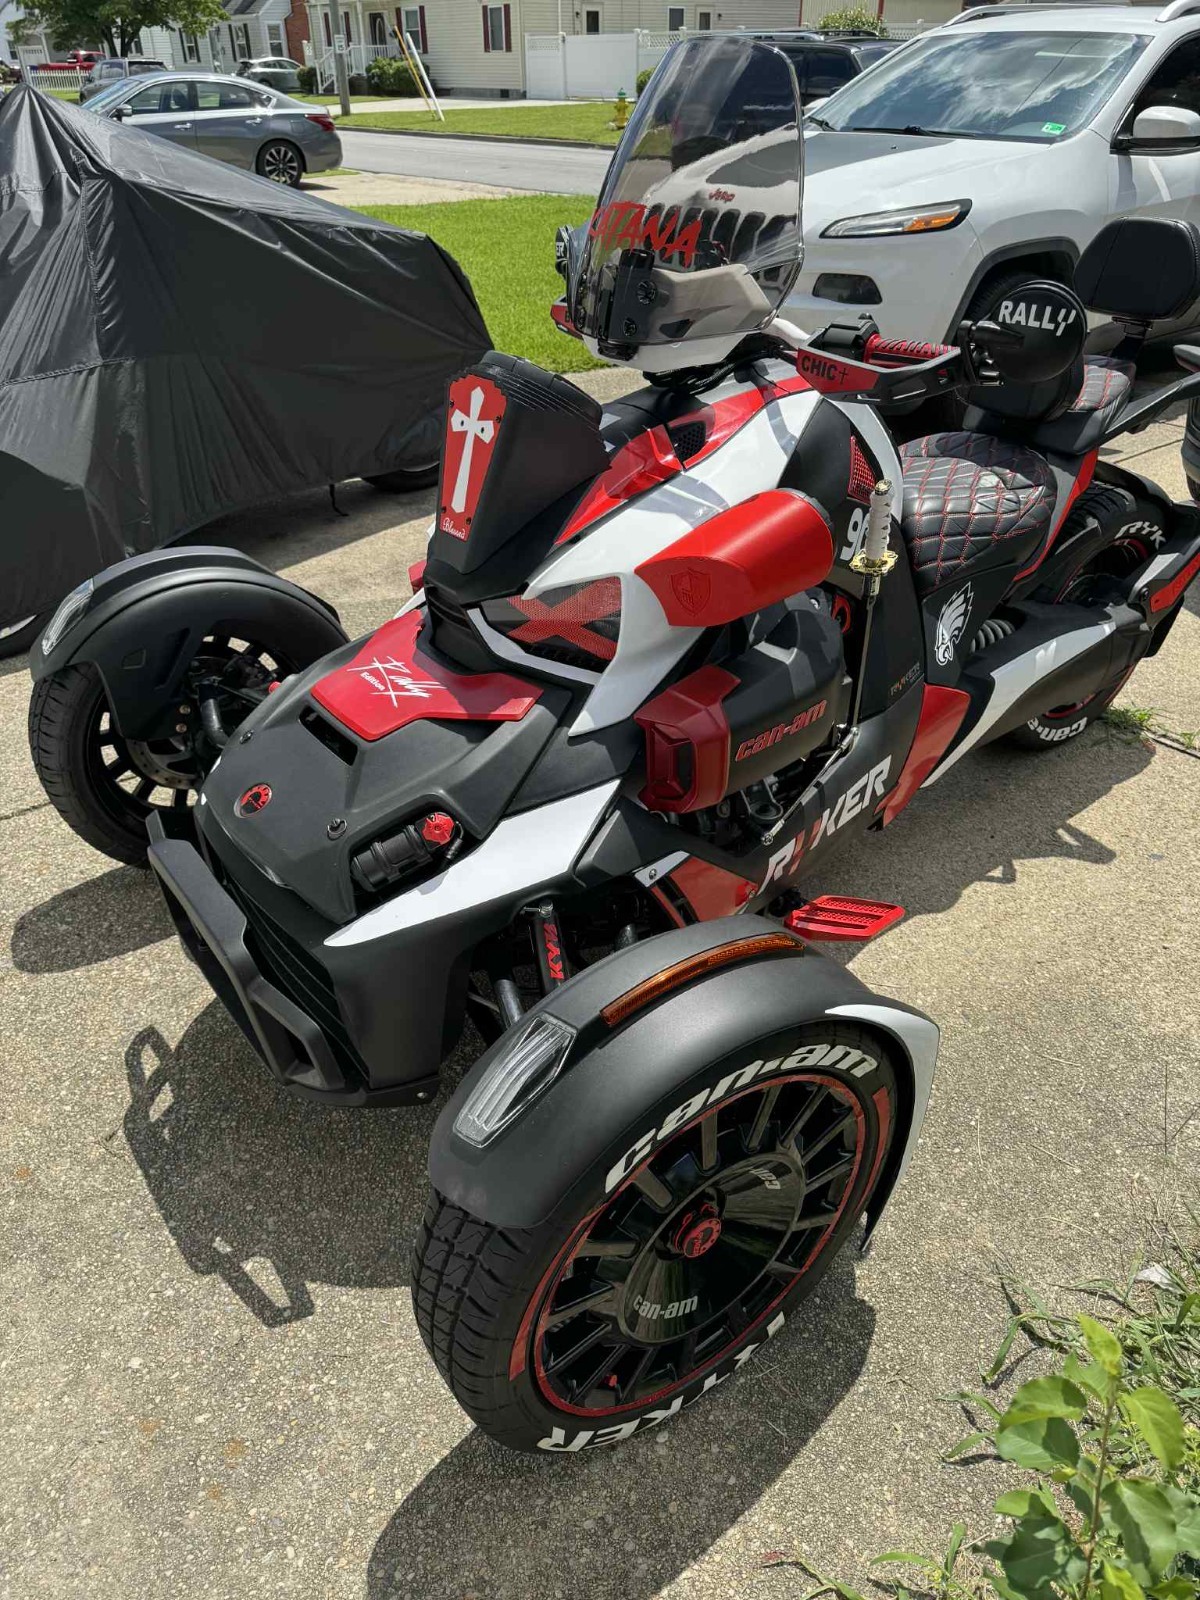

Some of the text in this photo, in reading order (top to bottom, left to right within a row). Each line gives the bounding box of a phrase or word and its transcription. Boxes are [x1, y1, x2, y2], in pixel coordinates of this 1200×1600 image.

[998, 300, 1077, 337] RALLY
[360, 671, 386, 691] Edition
[736, 700, 827, 762] can-am
[605, 1043, 878, 1194] can-am
[633, 1294, 698, 1320] can-am
